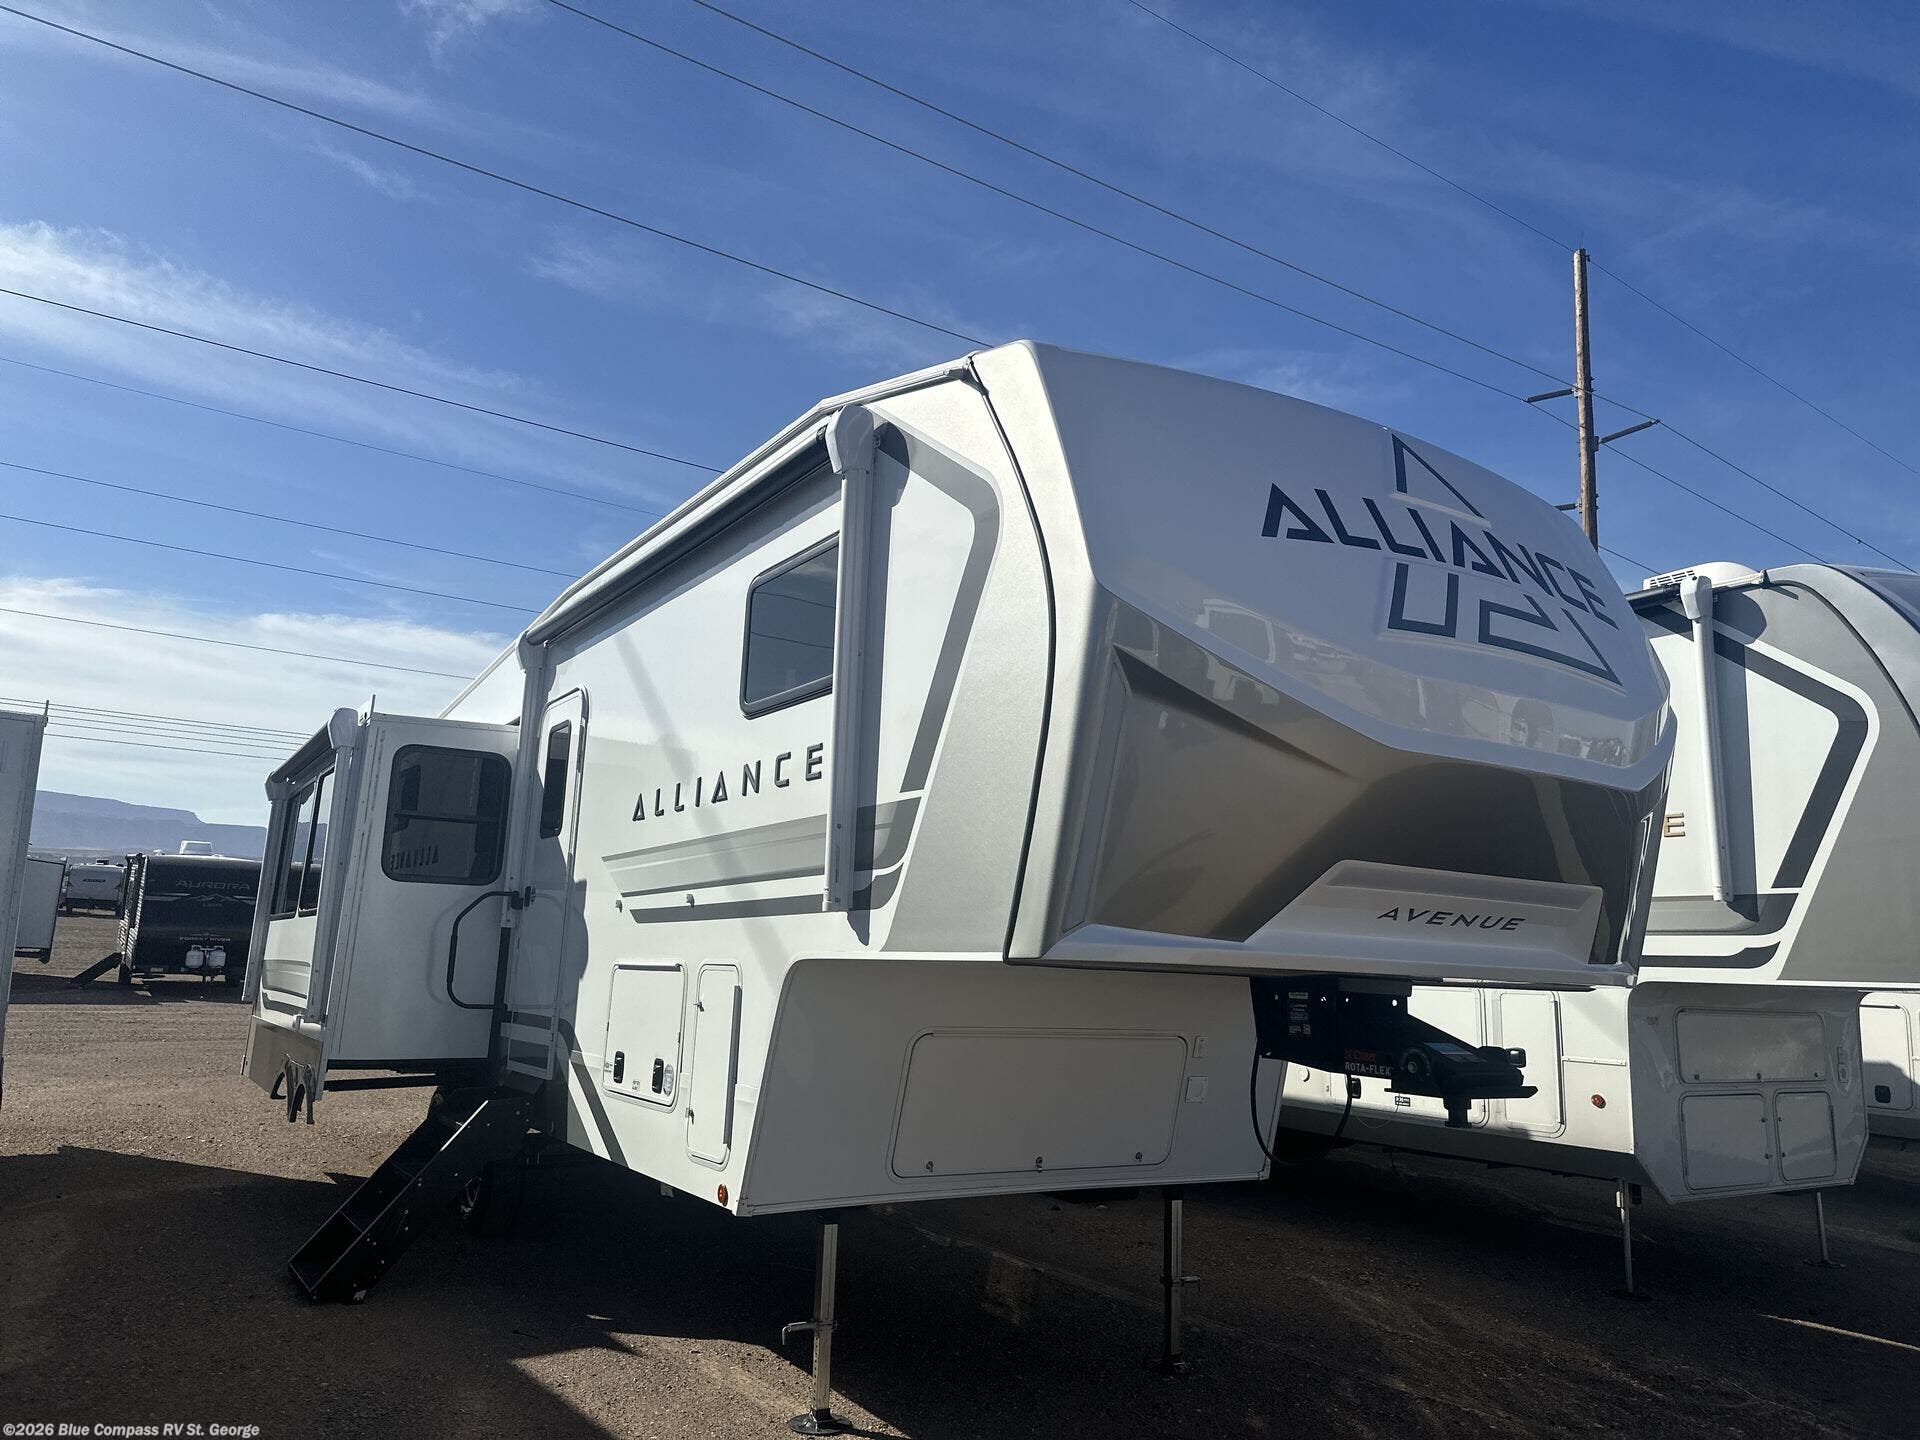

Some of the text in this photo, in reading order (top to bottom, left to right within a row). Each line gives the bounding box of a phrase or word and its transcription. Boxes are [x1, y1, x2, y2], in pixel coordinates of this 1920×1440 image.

[1261, 482, 1619, 631] ALLIANCE
[632, 742, 824, 822] ALLIANCE
[175, 880, 251, 891] AURORA
[1376, 906, 1526, 931] AVENUE
